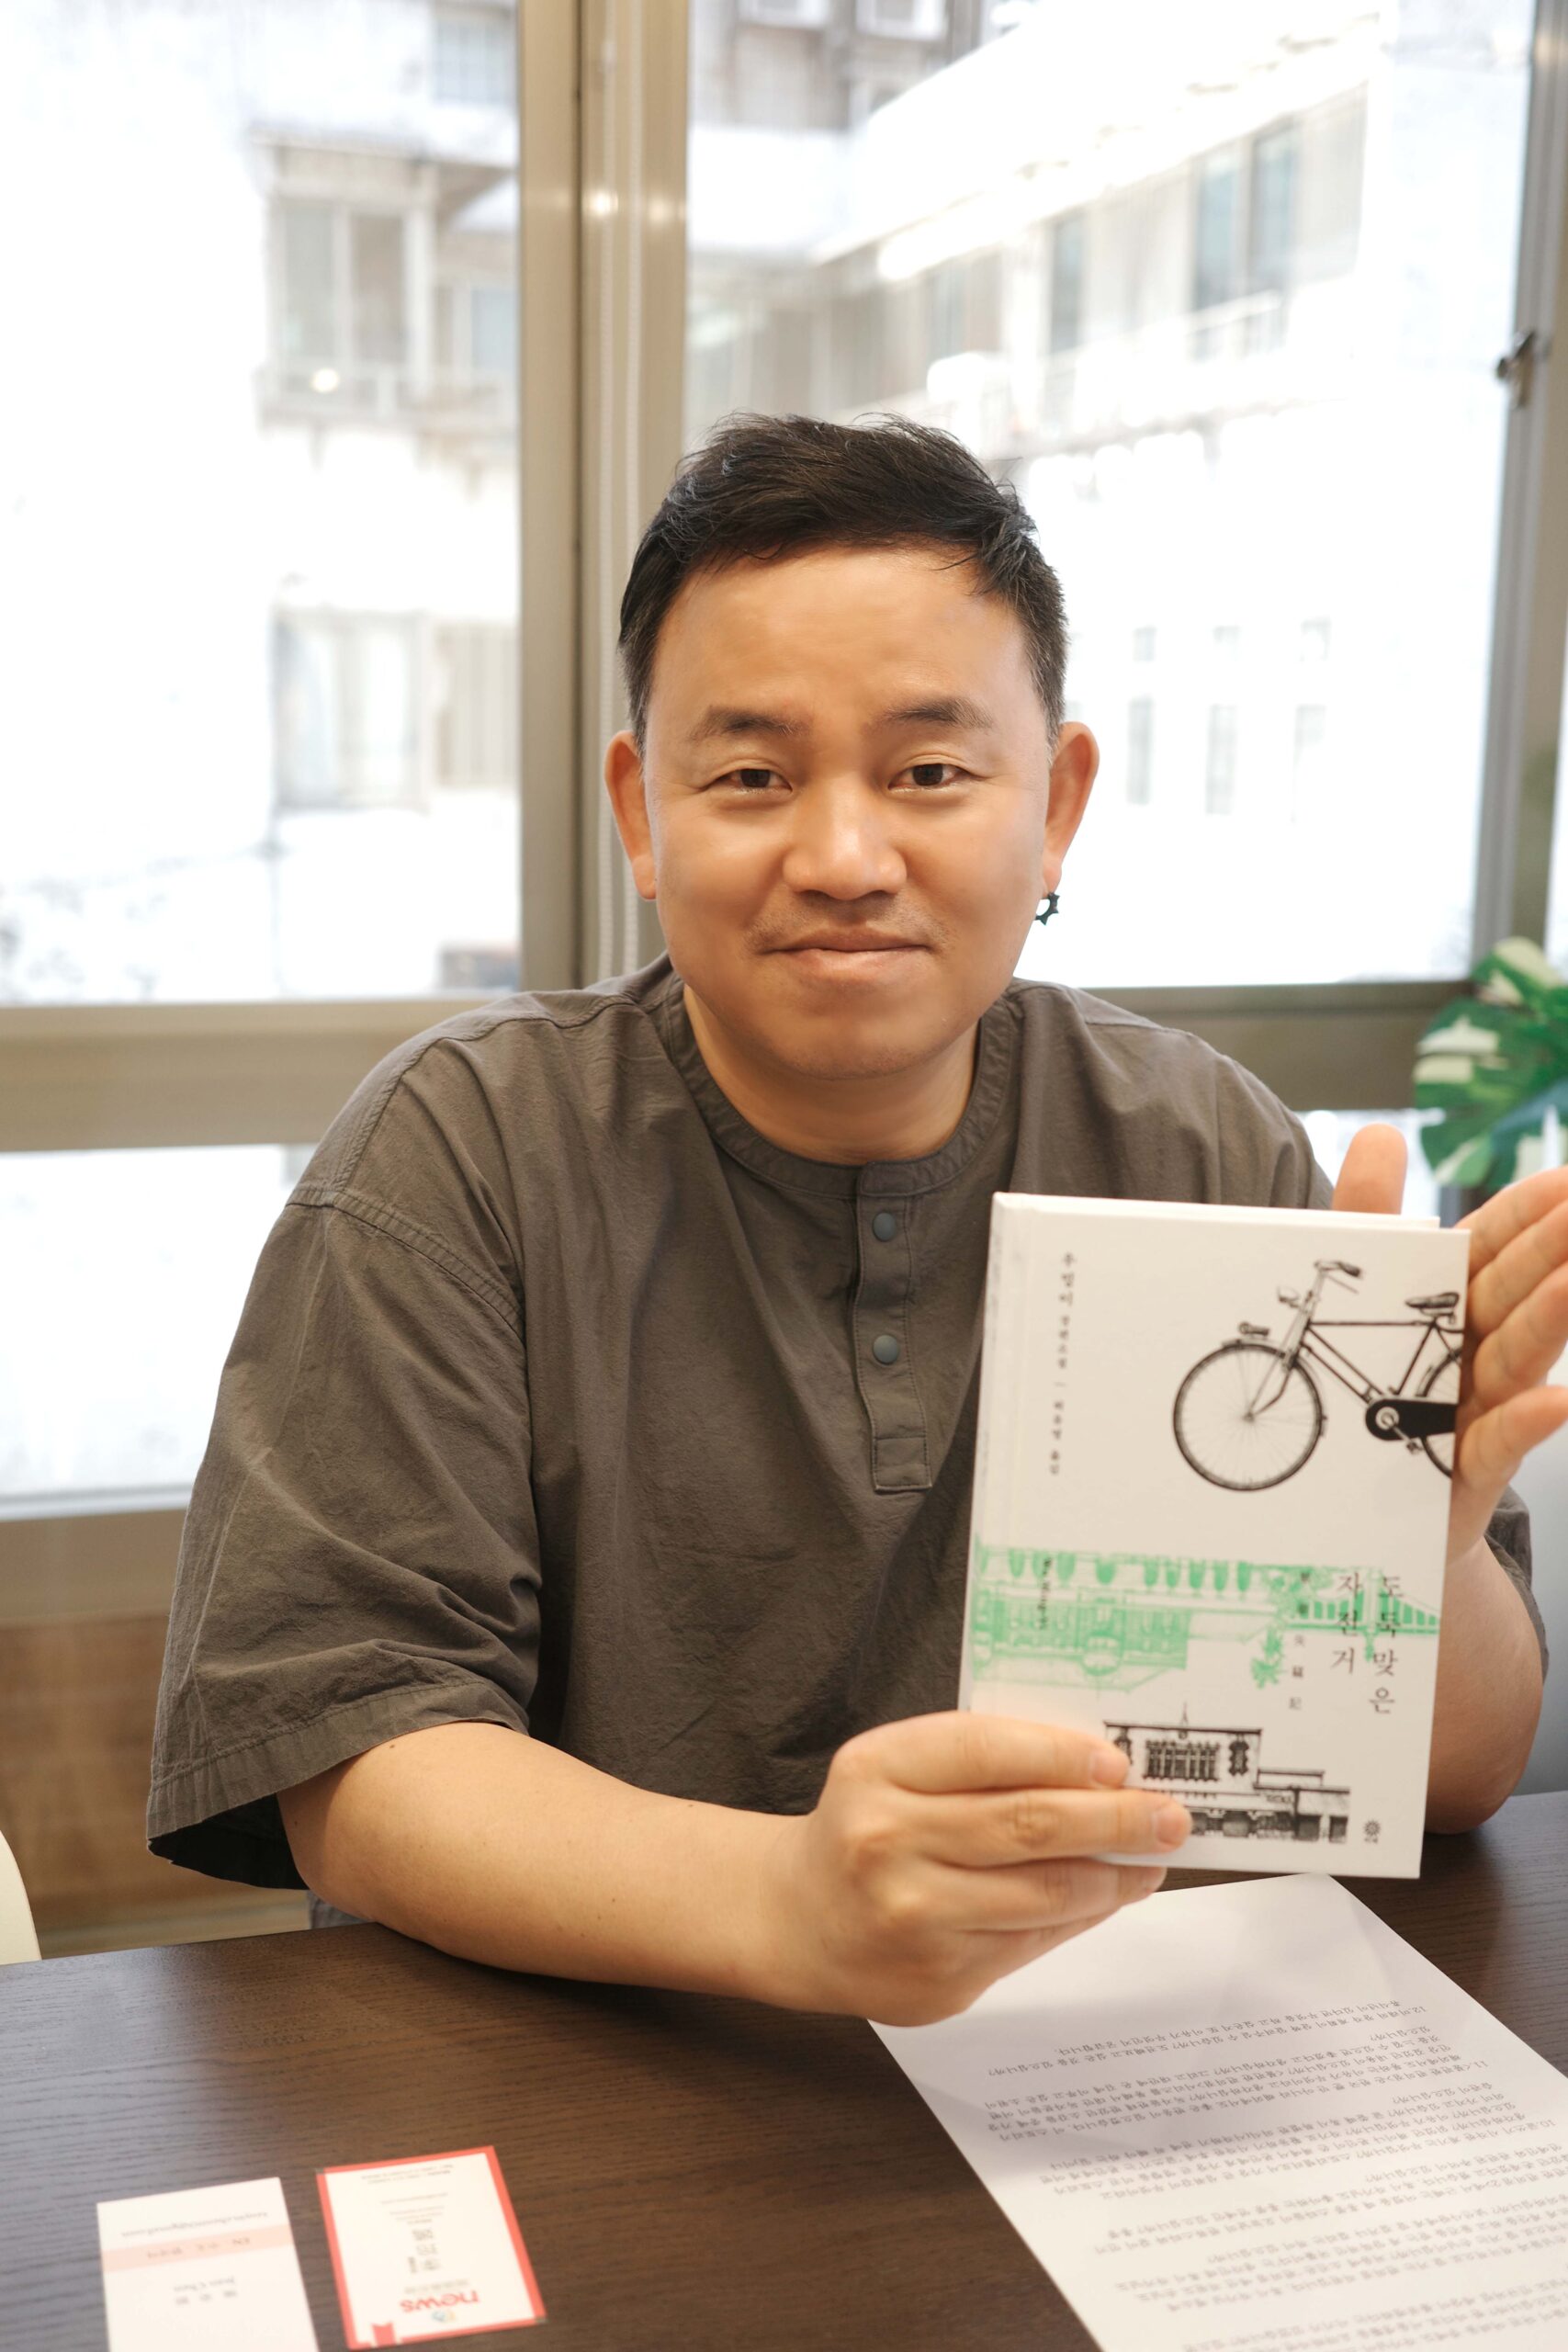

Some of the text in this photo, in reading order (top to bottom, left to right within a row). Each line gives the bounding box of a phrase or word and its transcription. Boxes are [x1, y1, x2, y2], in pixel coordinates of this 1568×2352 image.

[1331, 1572, 1362, 1675] 자전거
[1369, 1575, 1404, 1715] 도둑맞은
[1284, 2012, 1317, 2021] 무엇을
[1321, 2007, 1353, 2017] 있다면
[1315, 2018, 1347, 2028] 계획이
[1352, 2014, 1373, 2022] 창작
[1221, 2020, 1254, 2030] 싶은지
[1169, 2030, 1202, 2039] 이유가
[1242, 2027, 1286, 2039] 알려주실
[1120, 2034, 1166, 2046] 무엇인지
[1172, 2036, 1223, 2048] 있습니까?
[1111, 2044, 1168, 2056] 도전해보고
[1057, 2057, 1077, 2065] 것을
[1085, 2052, 1106, 2062] 싶은
[988, 2061, 1053, 2075] 있으십니까?
[399, 2290, 480, 2313] news
